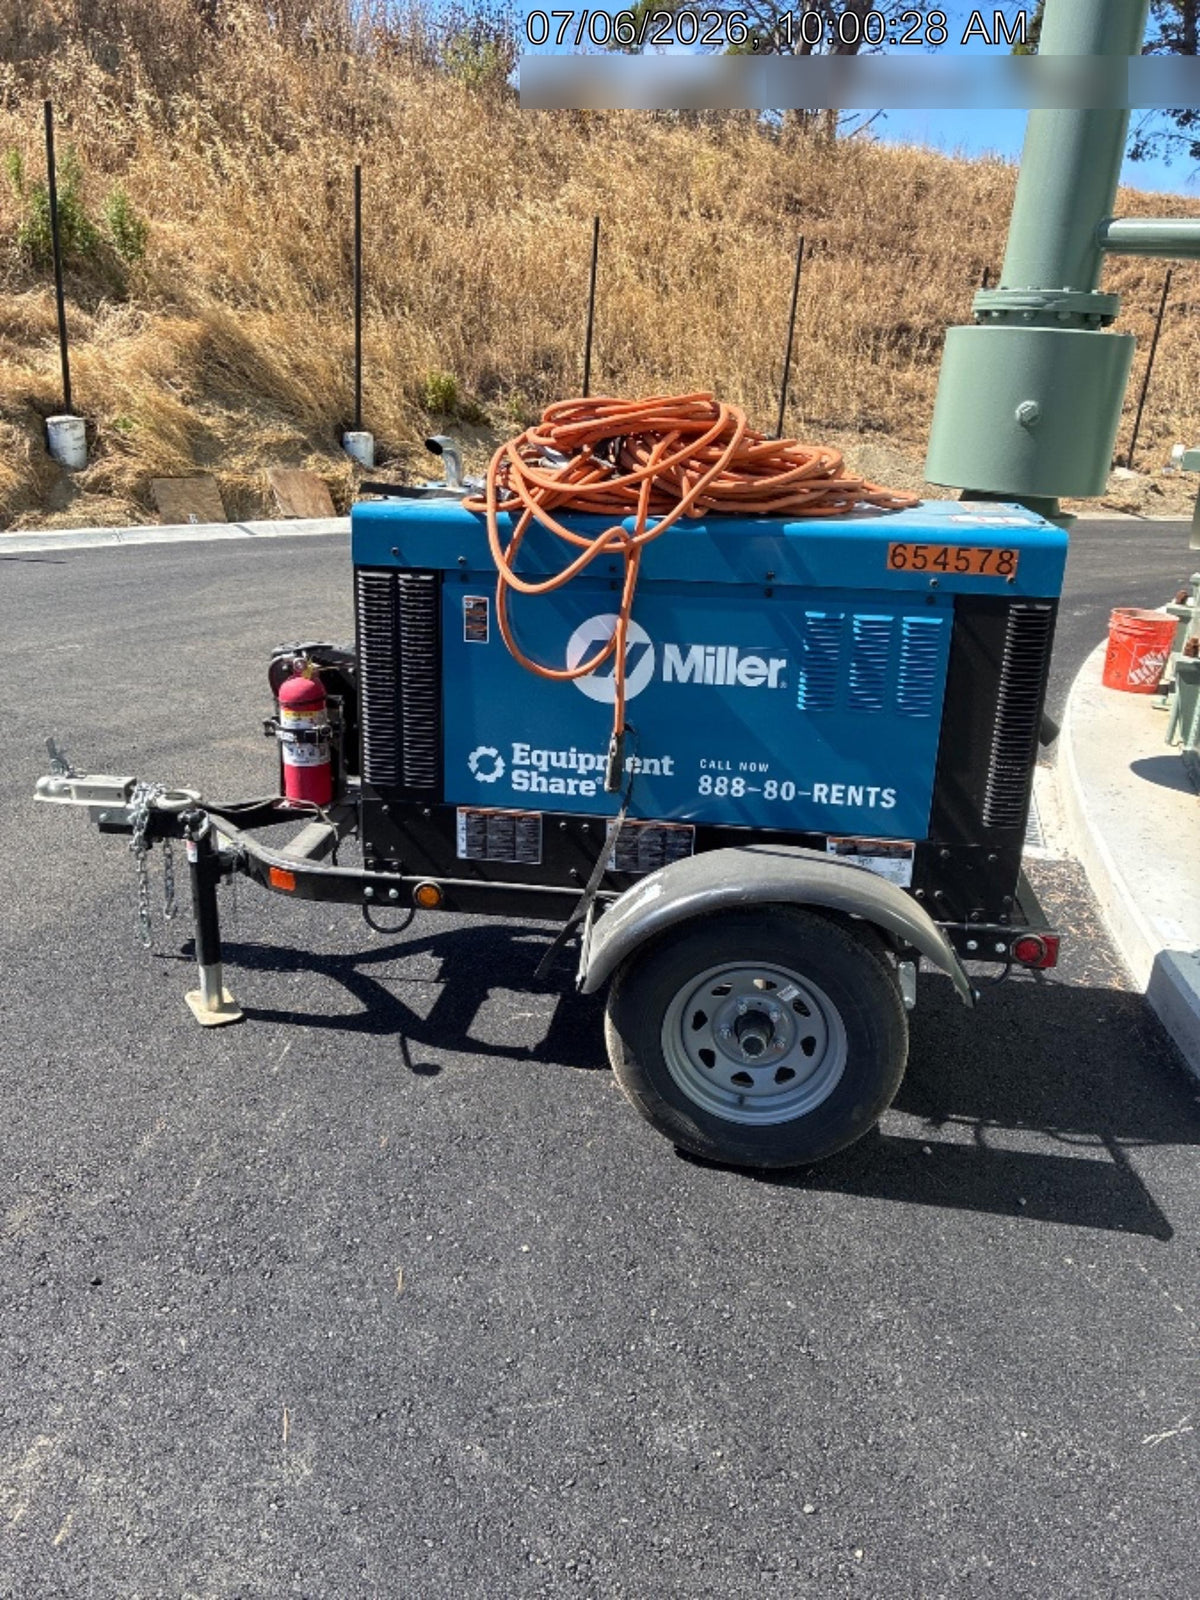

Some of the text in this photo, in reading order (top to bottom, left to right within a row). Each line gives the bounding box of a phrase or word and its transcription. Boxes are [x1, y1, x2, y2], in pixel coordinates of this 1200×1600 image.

[890, 543, 1015, 575] 654578
[662, 643, 787, 688] Miller
[511, 742, 675, 776] Equipent
[700, 758, 769, 773] CALL NOW
[698, 774, 897, 809] 888-80-RENTS
